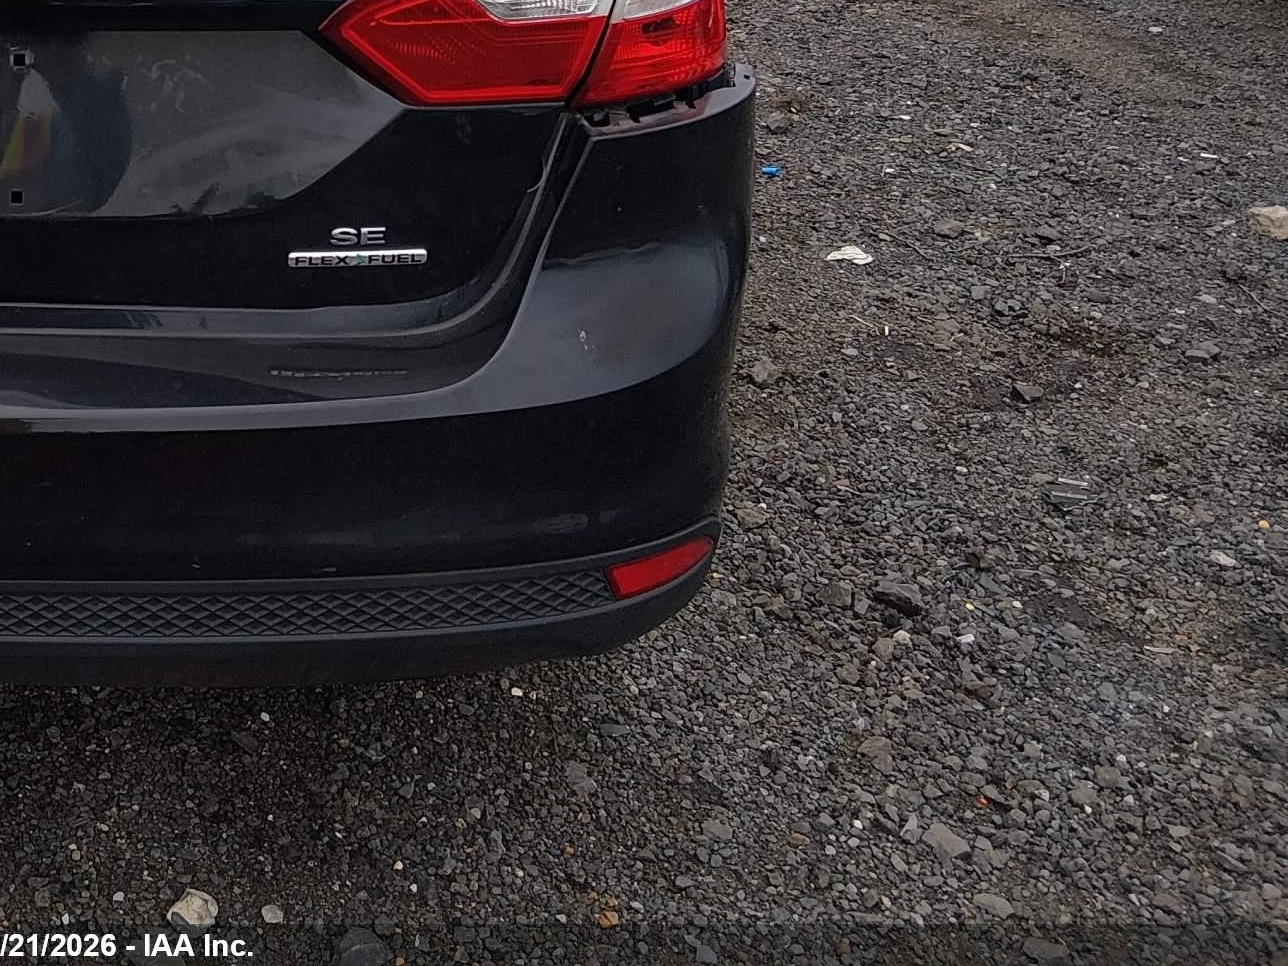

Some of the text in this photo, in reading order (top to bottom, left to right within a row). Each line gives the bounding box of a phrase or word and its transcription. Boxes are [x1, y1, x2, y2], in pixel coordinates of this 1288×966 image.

[329, 226, 387, 246] SE
[294, 253, 423, 266] FLEX FUEL
